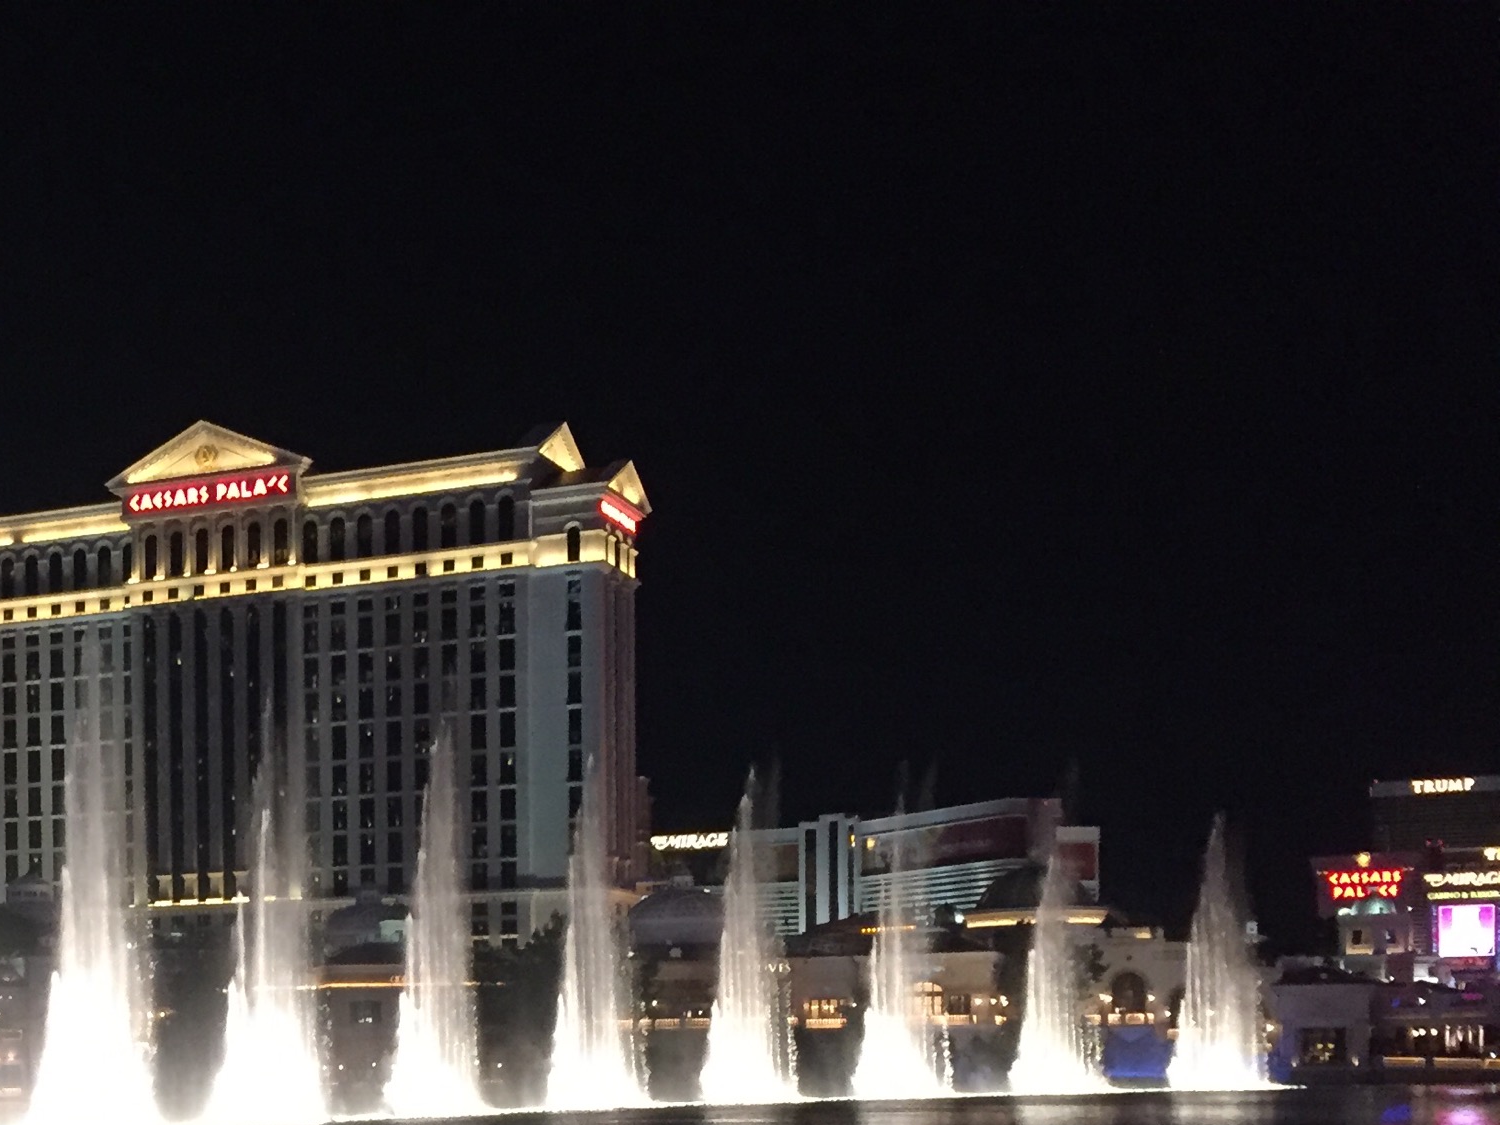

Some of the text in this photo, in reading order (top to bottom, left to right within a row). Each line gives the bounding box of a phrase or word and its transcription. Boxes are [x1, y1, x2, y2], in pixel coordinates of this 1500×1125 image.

[129, 485, 210, 512] CAESARS
[1411, 777, 1475, 794] TRUMP
[666, 832, 729, 850] MIRAGE
[1328, 870, 1402, 885] CAESARS
[1443, 870, 1500, 887] MIRAG
[1333, 884, 1398, 900] PALCE
